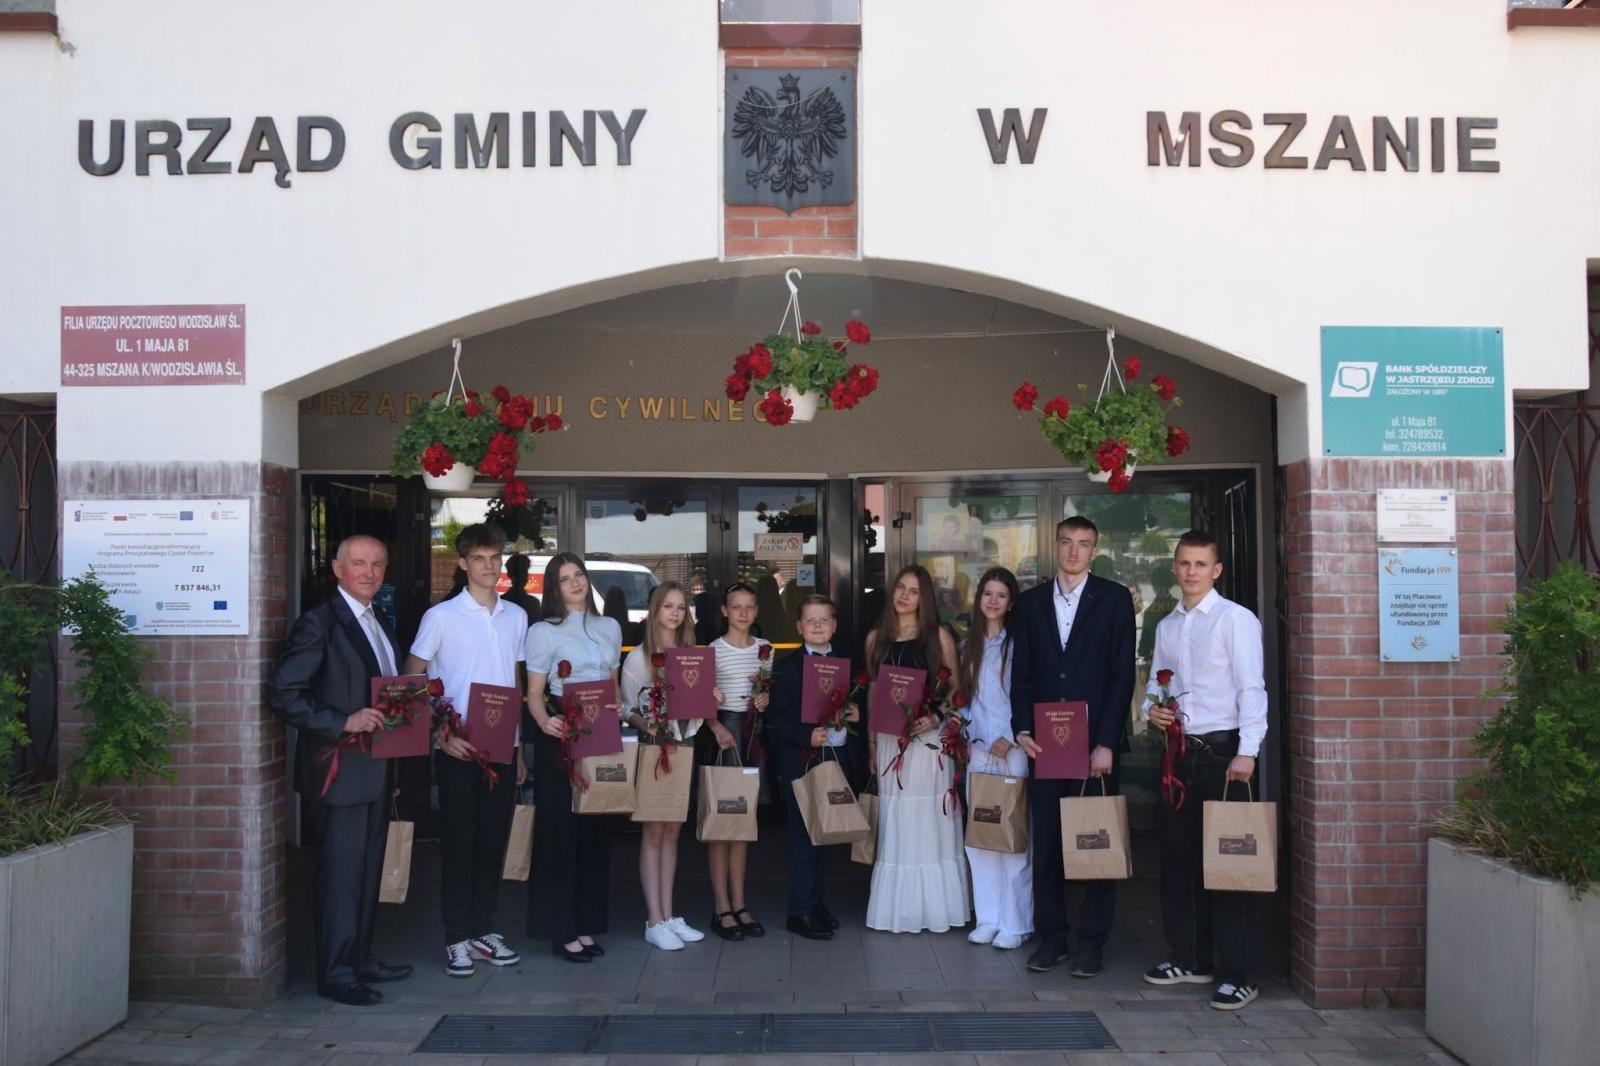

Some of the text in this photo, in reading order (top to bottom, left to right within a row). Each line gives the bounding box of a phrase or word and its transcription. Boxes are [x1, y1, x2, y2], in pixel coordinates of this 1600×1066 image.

[78, 107, 1500, 189] URZĄD GMINY W MSZANIE
[64, 312, 241, 332] FILIA URZĘDU POCZTOWEGO WODZISŁAW ŚL.
[116, 339, 189, 352] UL. 1 MAJA 81
[64, 358, 242, 377] 44-325 MSZANA K/WODZISŁAWIA ŚL.
[1386, 363, 1488, 374] BANK SPÓŁDZIELCZY
[1386, 375, 1396, 384] W
[1397, 375, 1455, 385] JASTRZĘBIU
[589, 396, 770, 422] CYWILNEG
[1408, 416, 1426, 428] Maja
[1401, 566, 1435, 576] Fundacja
[196, 584, 221, 592] 846,31
